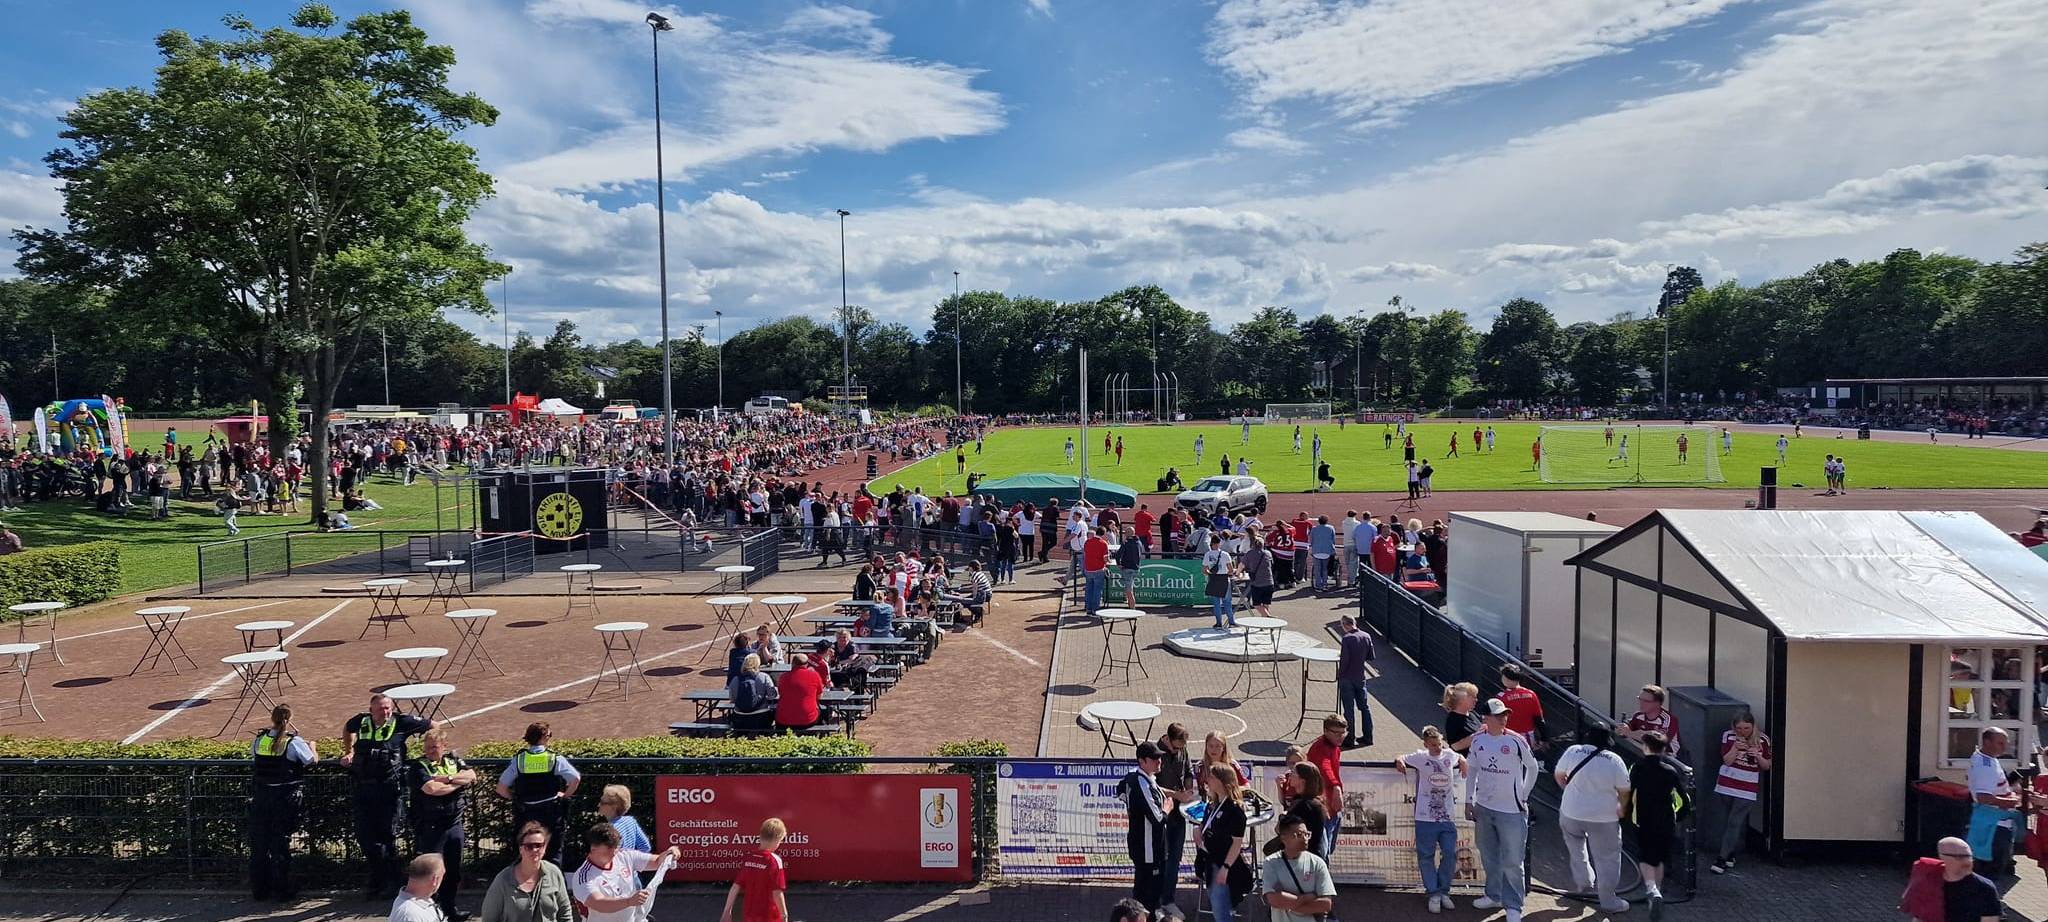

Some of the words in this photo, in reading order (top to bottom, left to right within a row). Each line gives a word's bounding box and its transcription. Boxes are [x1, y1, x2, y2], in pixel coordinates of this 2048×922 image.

[1111, 573, 1195, 589] ReinLand
[1054, 766, 1065, 776] 12.
[668, 788, 715, 803] ERGO
[1079, 783, 1094, 797] 10.
[1098, 783, 1118, 798] Aug
[668, 820, 738, 828] Geschäftsstelle
[669, 832, 729, 847] Georgios
[1365, 838, 1411, 847] vermieten
[925, 842, 954, 851] ERGO
[683, 850, 709, 858] 02131
[711, 850, 744, 858] 409404
[790, 850, 801, 858] 50
[803, 850, 820, 858] 838
